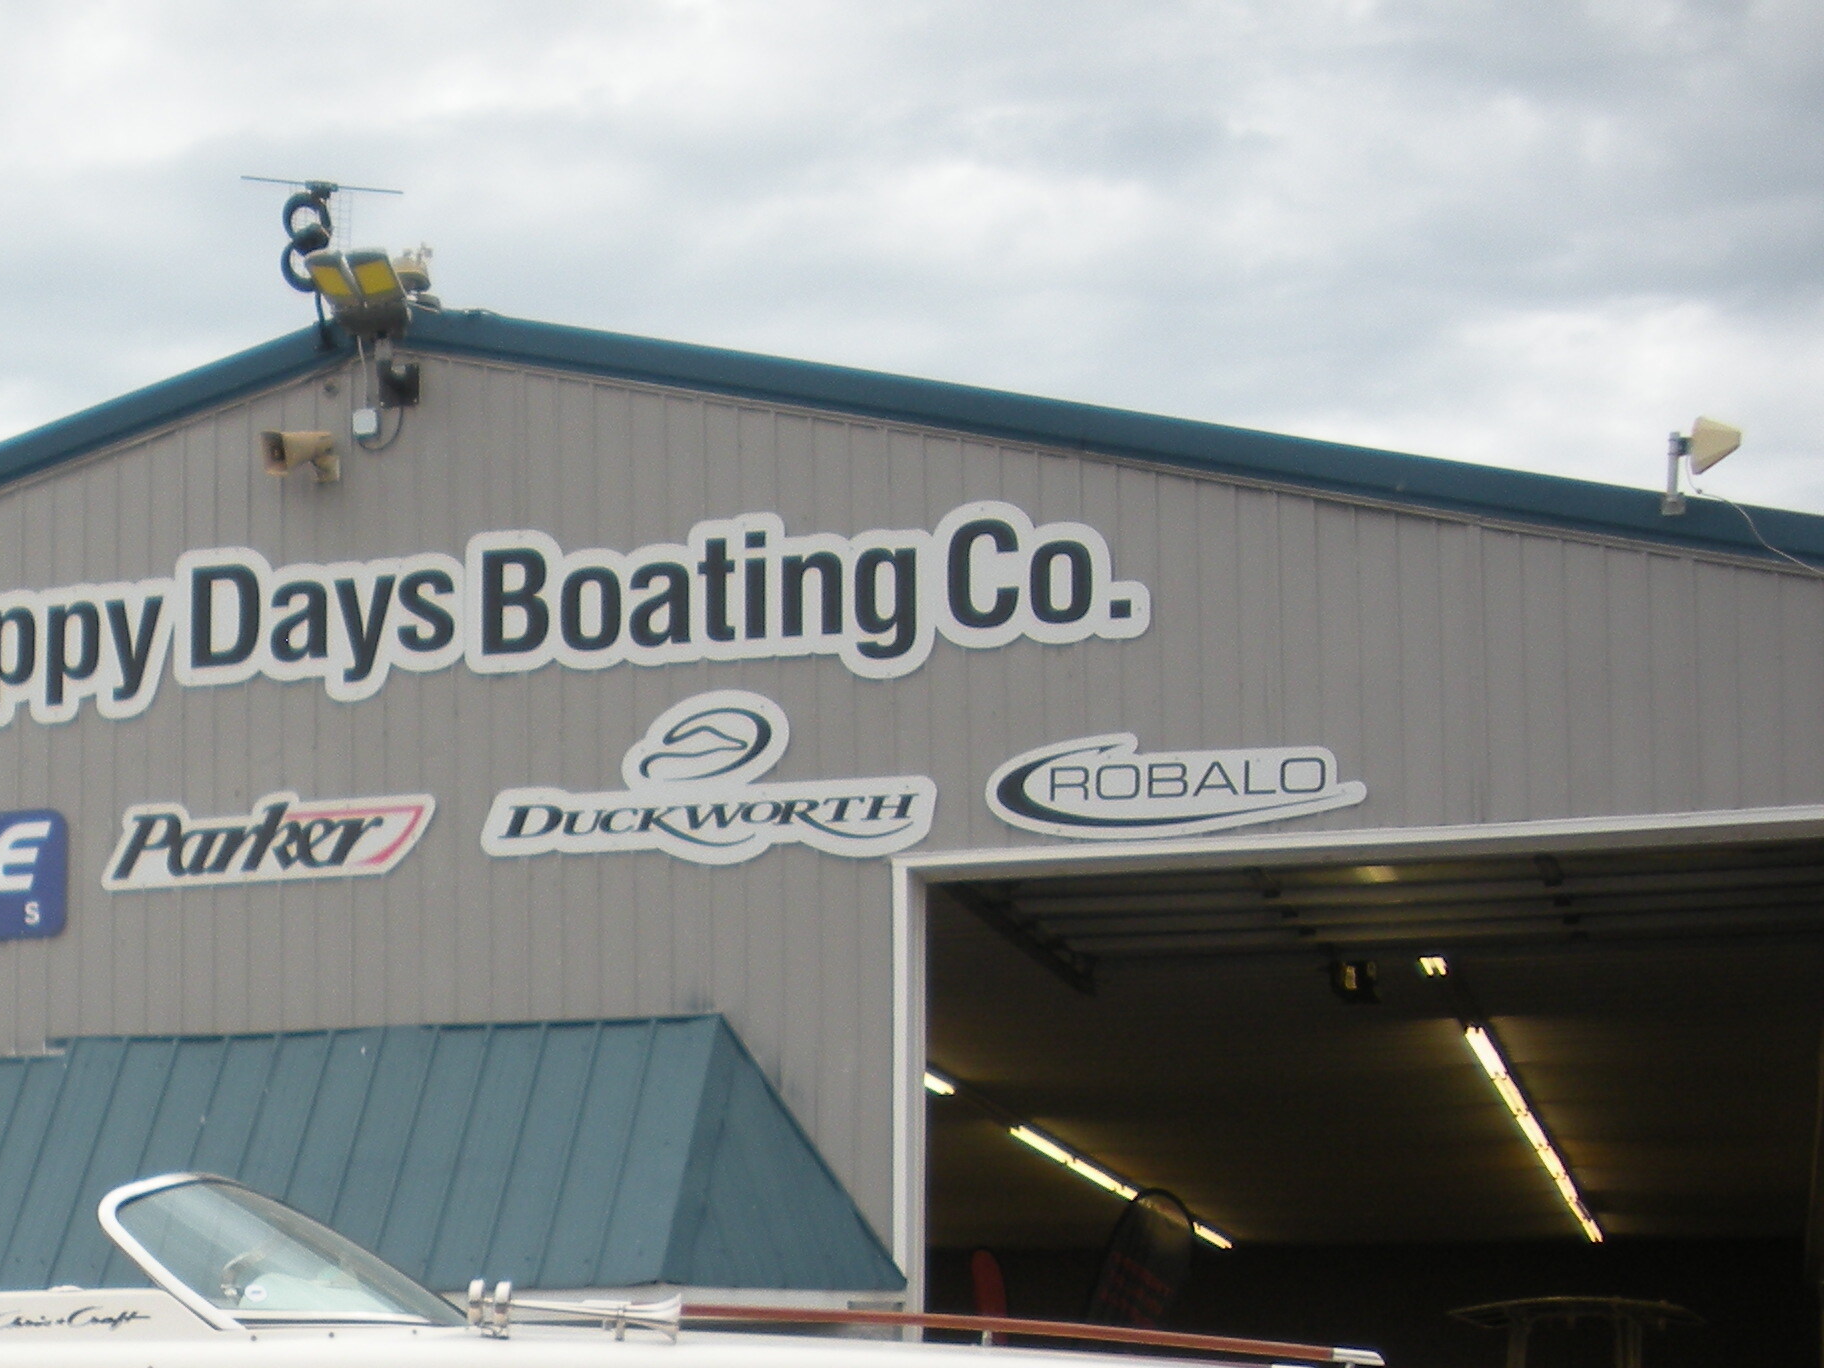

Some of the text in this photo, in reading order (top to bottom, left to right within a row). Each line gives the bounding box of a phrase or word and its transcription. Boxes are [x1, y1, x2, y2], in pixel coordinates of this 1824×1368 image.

[191, 562, 455, 684] Days
[481, 530, 917, 660] Boating
[947, 518, 1133, 629] Co.
[1049, 757, 1326, 801] ROBALO
[111, 801, 384, 880] Parker
